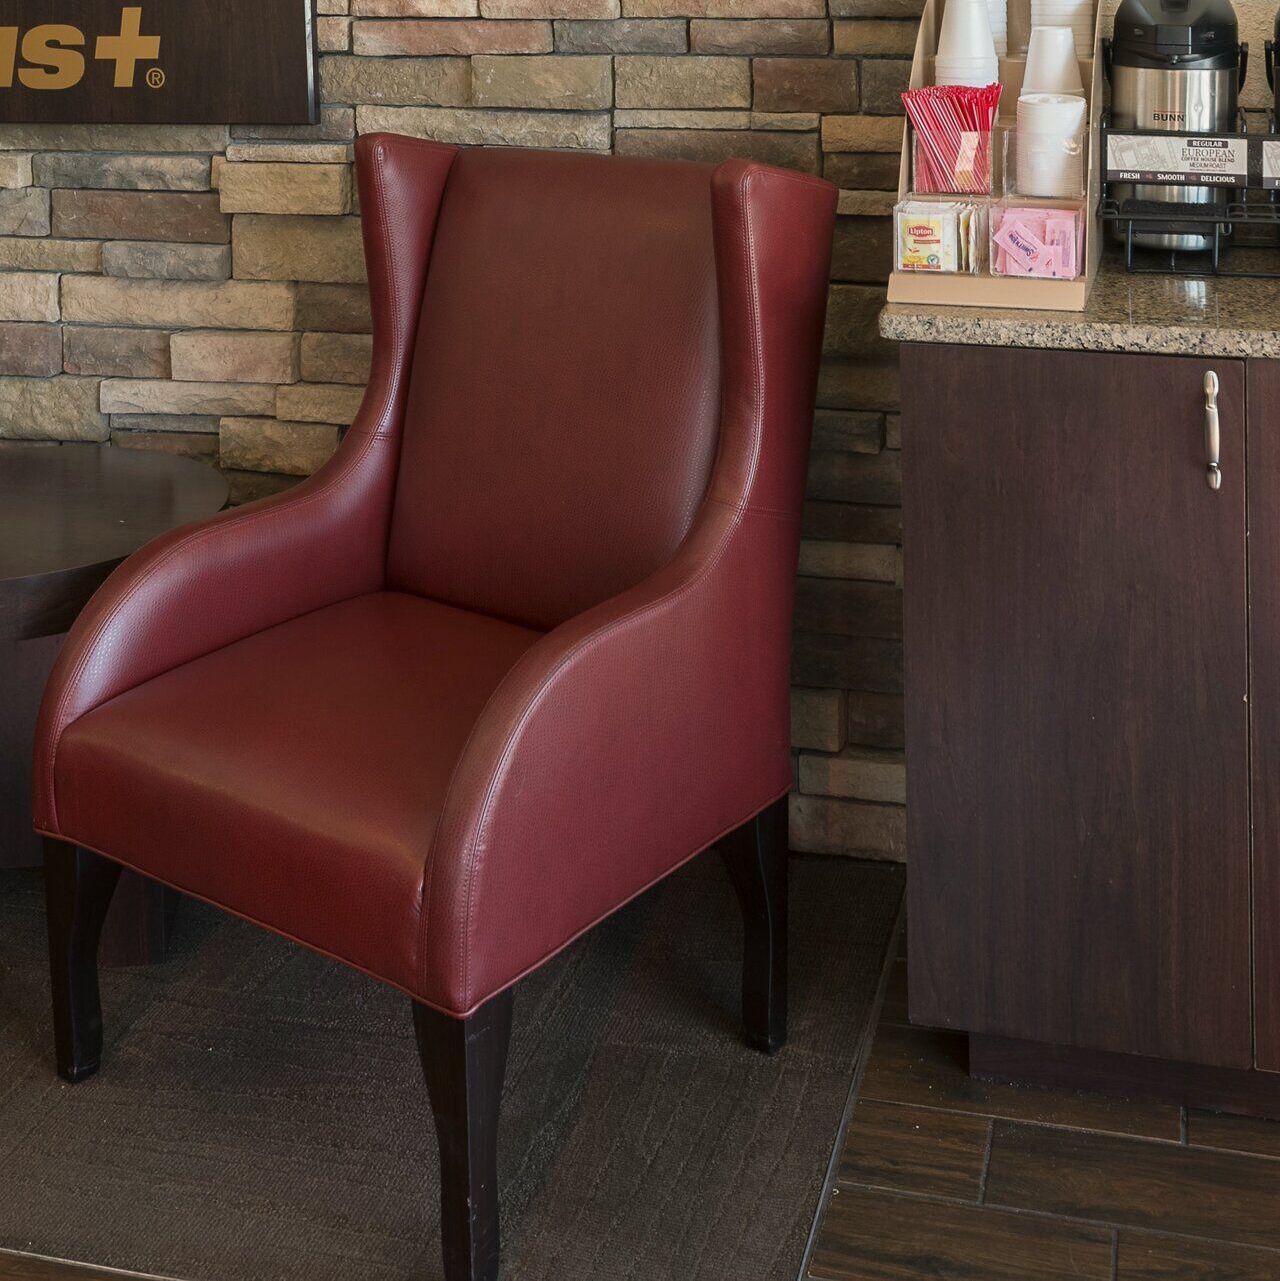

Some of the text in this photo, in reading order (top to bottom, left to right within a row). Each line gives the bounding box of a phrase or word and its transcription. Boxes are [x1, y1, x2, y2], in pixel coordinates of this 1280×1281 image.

[1153, 113, 1184, 122] BUNN
[1192, 140, 1223, 148] REGULAR
[1182, 148, 1235, 158] EUROPEAN
[1200, 175, 1235, 183] DELICIOUS
